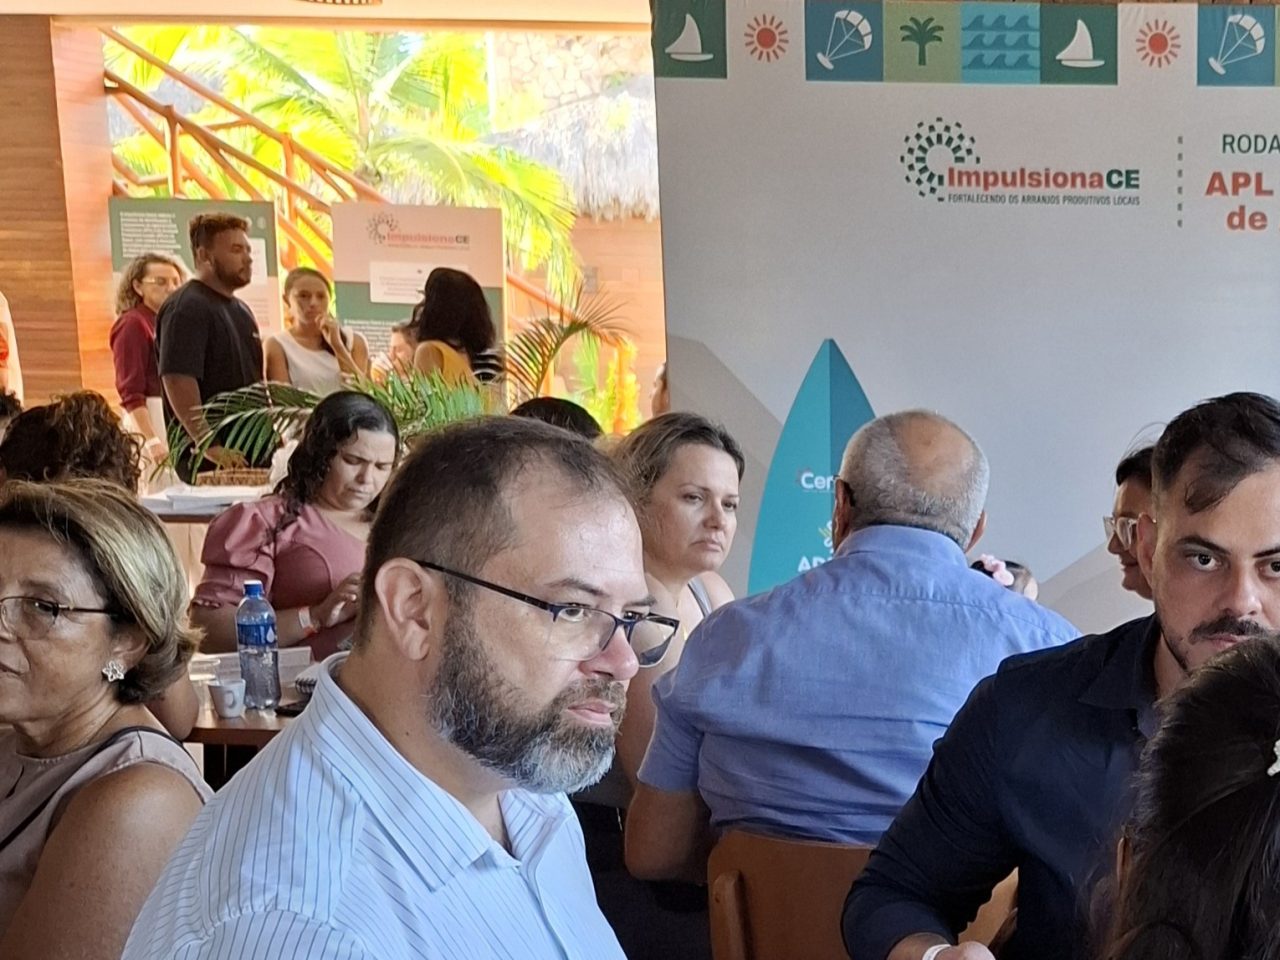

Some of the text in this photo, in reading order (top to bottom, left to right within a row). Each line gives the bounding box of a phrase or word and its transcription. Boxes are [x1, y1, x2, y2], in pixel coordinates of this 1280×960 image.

[948, 168, 1140, 191] ImpulsionaCE
[1205, 172, 1274, 197] APL
[948, 193, 1141, 206] FORTALECENDO OS ARRANJOS PRODUTIVOS LOCAIS
[1227, 205, 1268, 230] de
